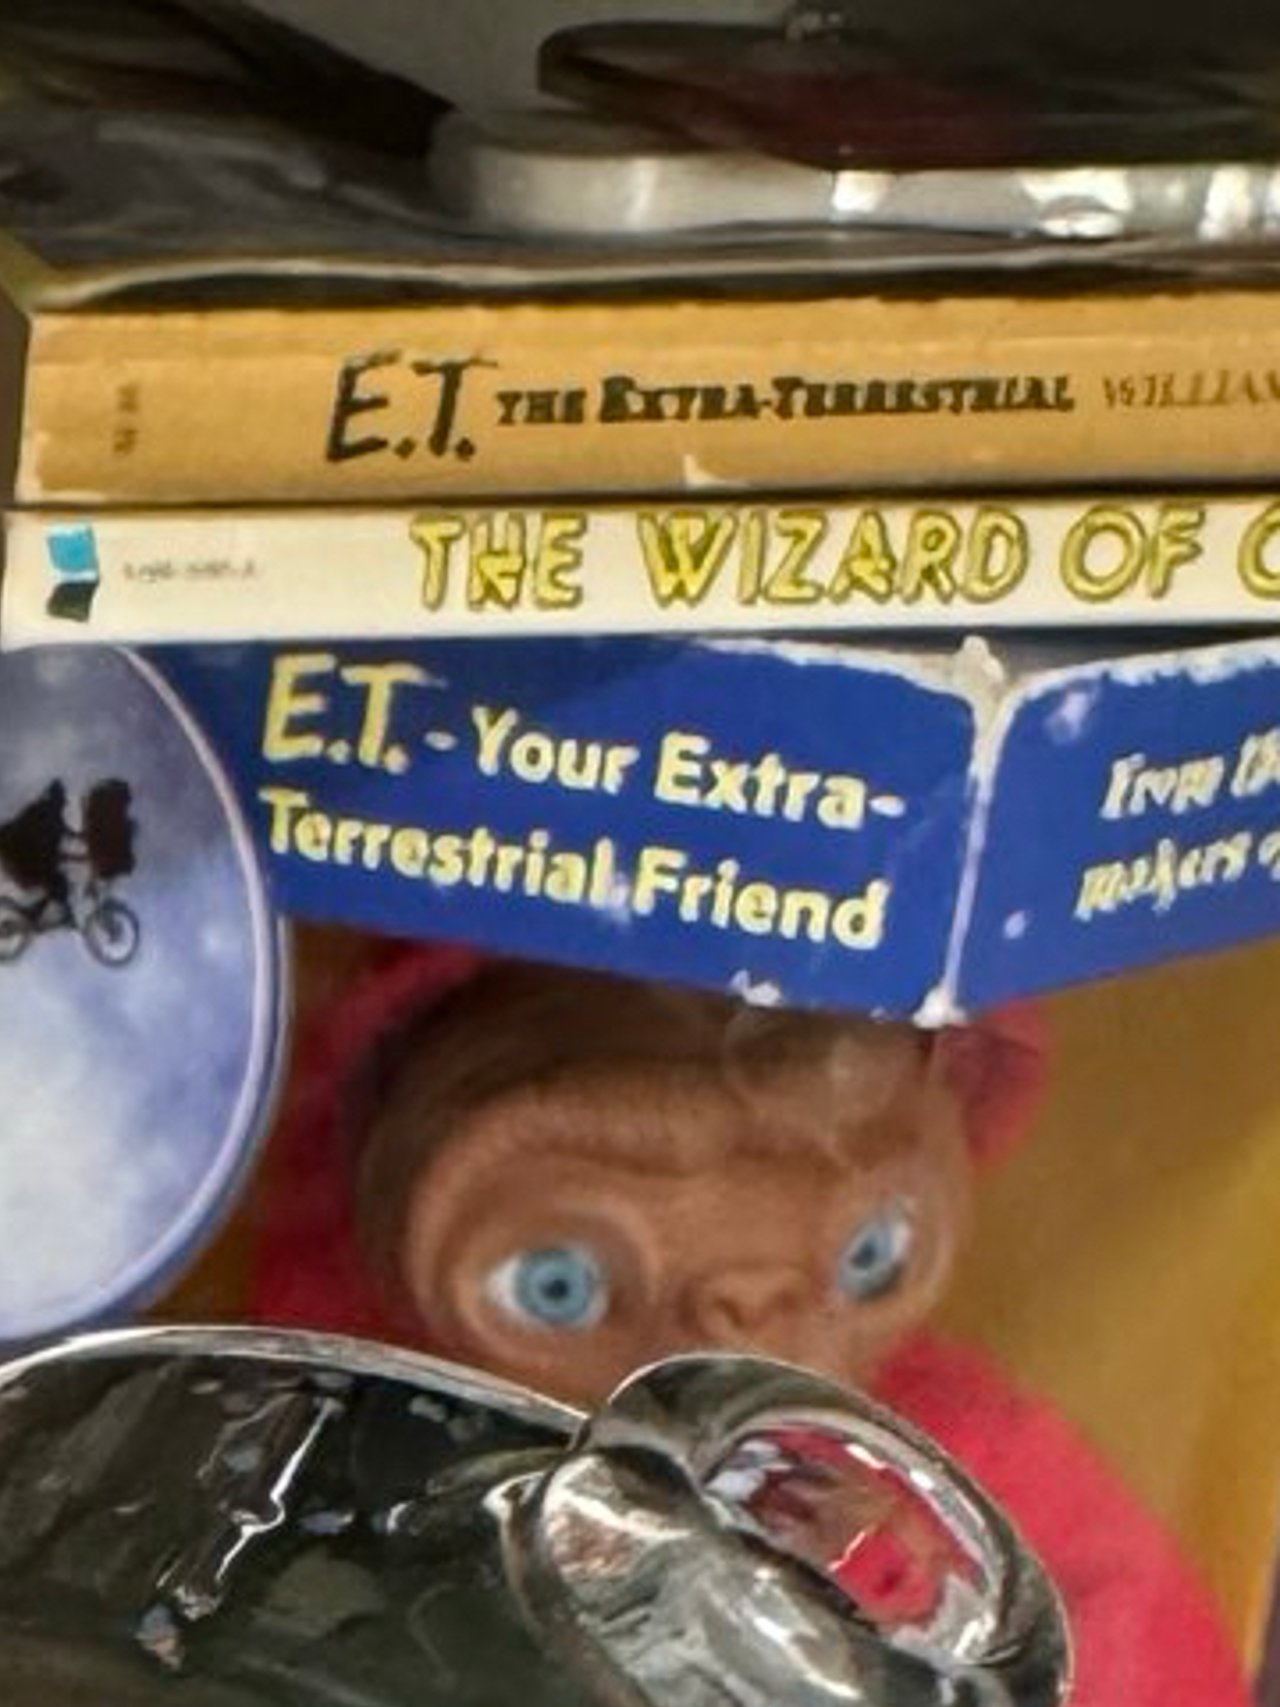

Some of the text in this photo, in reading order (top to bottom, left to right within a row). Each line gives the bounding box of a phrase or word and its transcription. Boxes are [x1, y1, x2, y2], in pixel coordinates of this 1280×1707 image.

[326, 350, 498, 461] E.T.
[497, 386, 585, 427] THE
[408, 512, 590, 609] THE
[638, 504, 1030, 606] WIZARD
[1058, 502, 1206, 604] OF
[260, 652, 446, 774] E.T.
[470, 704, 641, 796] Your
[652, 730, 908, 832] Extra-
[256, 786, 893, 952] Terrestrial Friend
